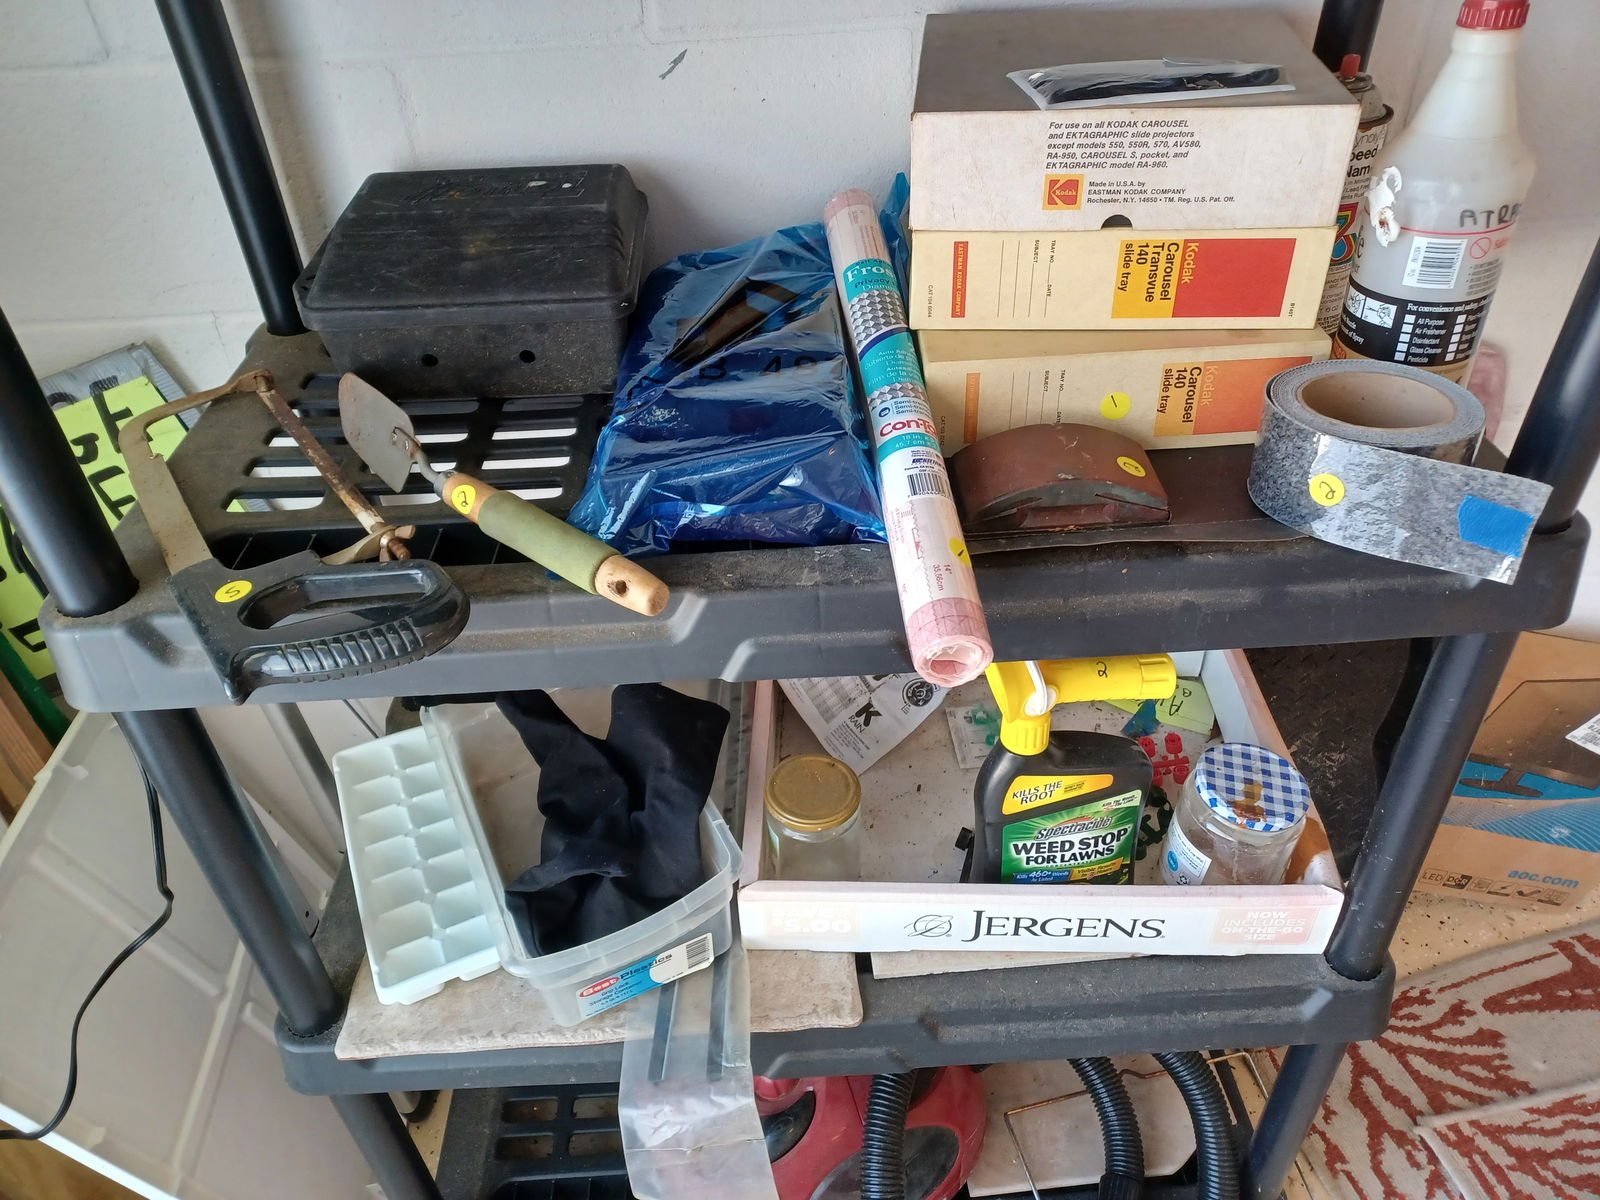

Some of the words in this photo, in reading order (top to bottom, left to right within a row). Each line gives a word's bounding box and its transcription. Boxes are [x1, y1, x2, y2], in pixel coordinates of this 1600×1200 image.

[1049, 121, 1063, 130] For
[1094, 121, 1105, 129] all
[1106, 120, 1139, 129] KODAK
[1140, 120, 1189, 128] CAROUSEL
[1048, 132, 1064, 140] and
[1065, 131, 1129, 139] EKTAGRAPHIC
[1152, 130, 1195, 140] projectors
[1047, 142, 1075, 151] except
[1076, 141, 1106, 149] models
[1108, 141, 1125, 150] 550,
[1127, 141, 1150, 150] 550R,
[1153, 141, 1170, 149] 570,
[1172, 140, 1201, 149] AV580,
[1045, 161, 1108, 170] EKTAGRAPHIC
[1109, 161, 1135, 169] model
[1136, 161, 1169, 169] RA-960.
[1046, 152, 1078, 161] RA-950,
[1080, 151, 1128, 159] CAROUSEL
[1129, 151, 1138, 160] S,
[1140, 151, 1171, 161] pocket,
[1172, 151, 1189, 159] and
[1055, 188, 1077, 196] Kodak
[1087, 188, 1122, 196] EASTMAN
[1123, 188, 1148, 196] KODAK
[1137, 181, 1146, 189] by
[1177, 196, 1192, 204] Reg.
[1122, 243, 1135, 269] slide
[1136, 242, 1150, 265] 140
[1181, 242, 1200, 284] Kodak
[1145, 242, 1165, 303] Transvue
[1159, 242, 1180, 301] Carousel
[1117, 271, 1132, 292] tray
[1424, 318, 1445, 326] Purpose
[1162, 368, 1174, 393] slide
[1174, 367, 1188, 389] 140
[1200, 365, 1218, 407] Kodak
[1157, 394, 1170, 414] tray
[1182, 366, 1202, 423] Carousel
[1095, 661, 1108, 678] 2
[848, 715, 866, 734] RAIN
[1012, 786, 1040, 799] KILLS
[1043, 780, 1063, 793] THE
[1020, 790, 1056, 805] ROOT
[1036, 816, 1112, 840] Spectracide
[1012, 840, 1075, 856] WEED
[1078, 828, 1128, 850] STOP
[1025, 854, 1058, 866] FOR
[1060, 845, 1115, 863] LAWNS
[1422, 872, 1443, 882] LED
[1507, 869, 1580, 888] aoc.com
[1247, 911, 1288, 919] NOW
[961, 910, 1165, 942] JERGENS
[1222, 926, 1303, 934] ON-THE-GO
[620, 953, 673, 980] Plastics
